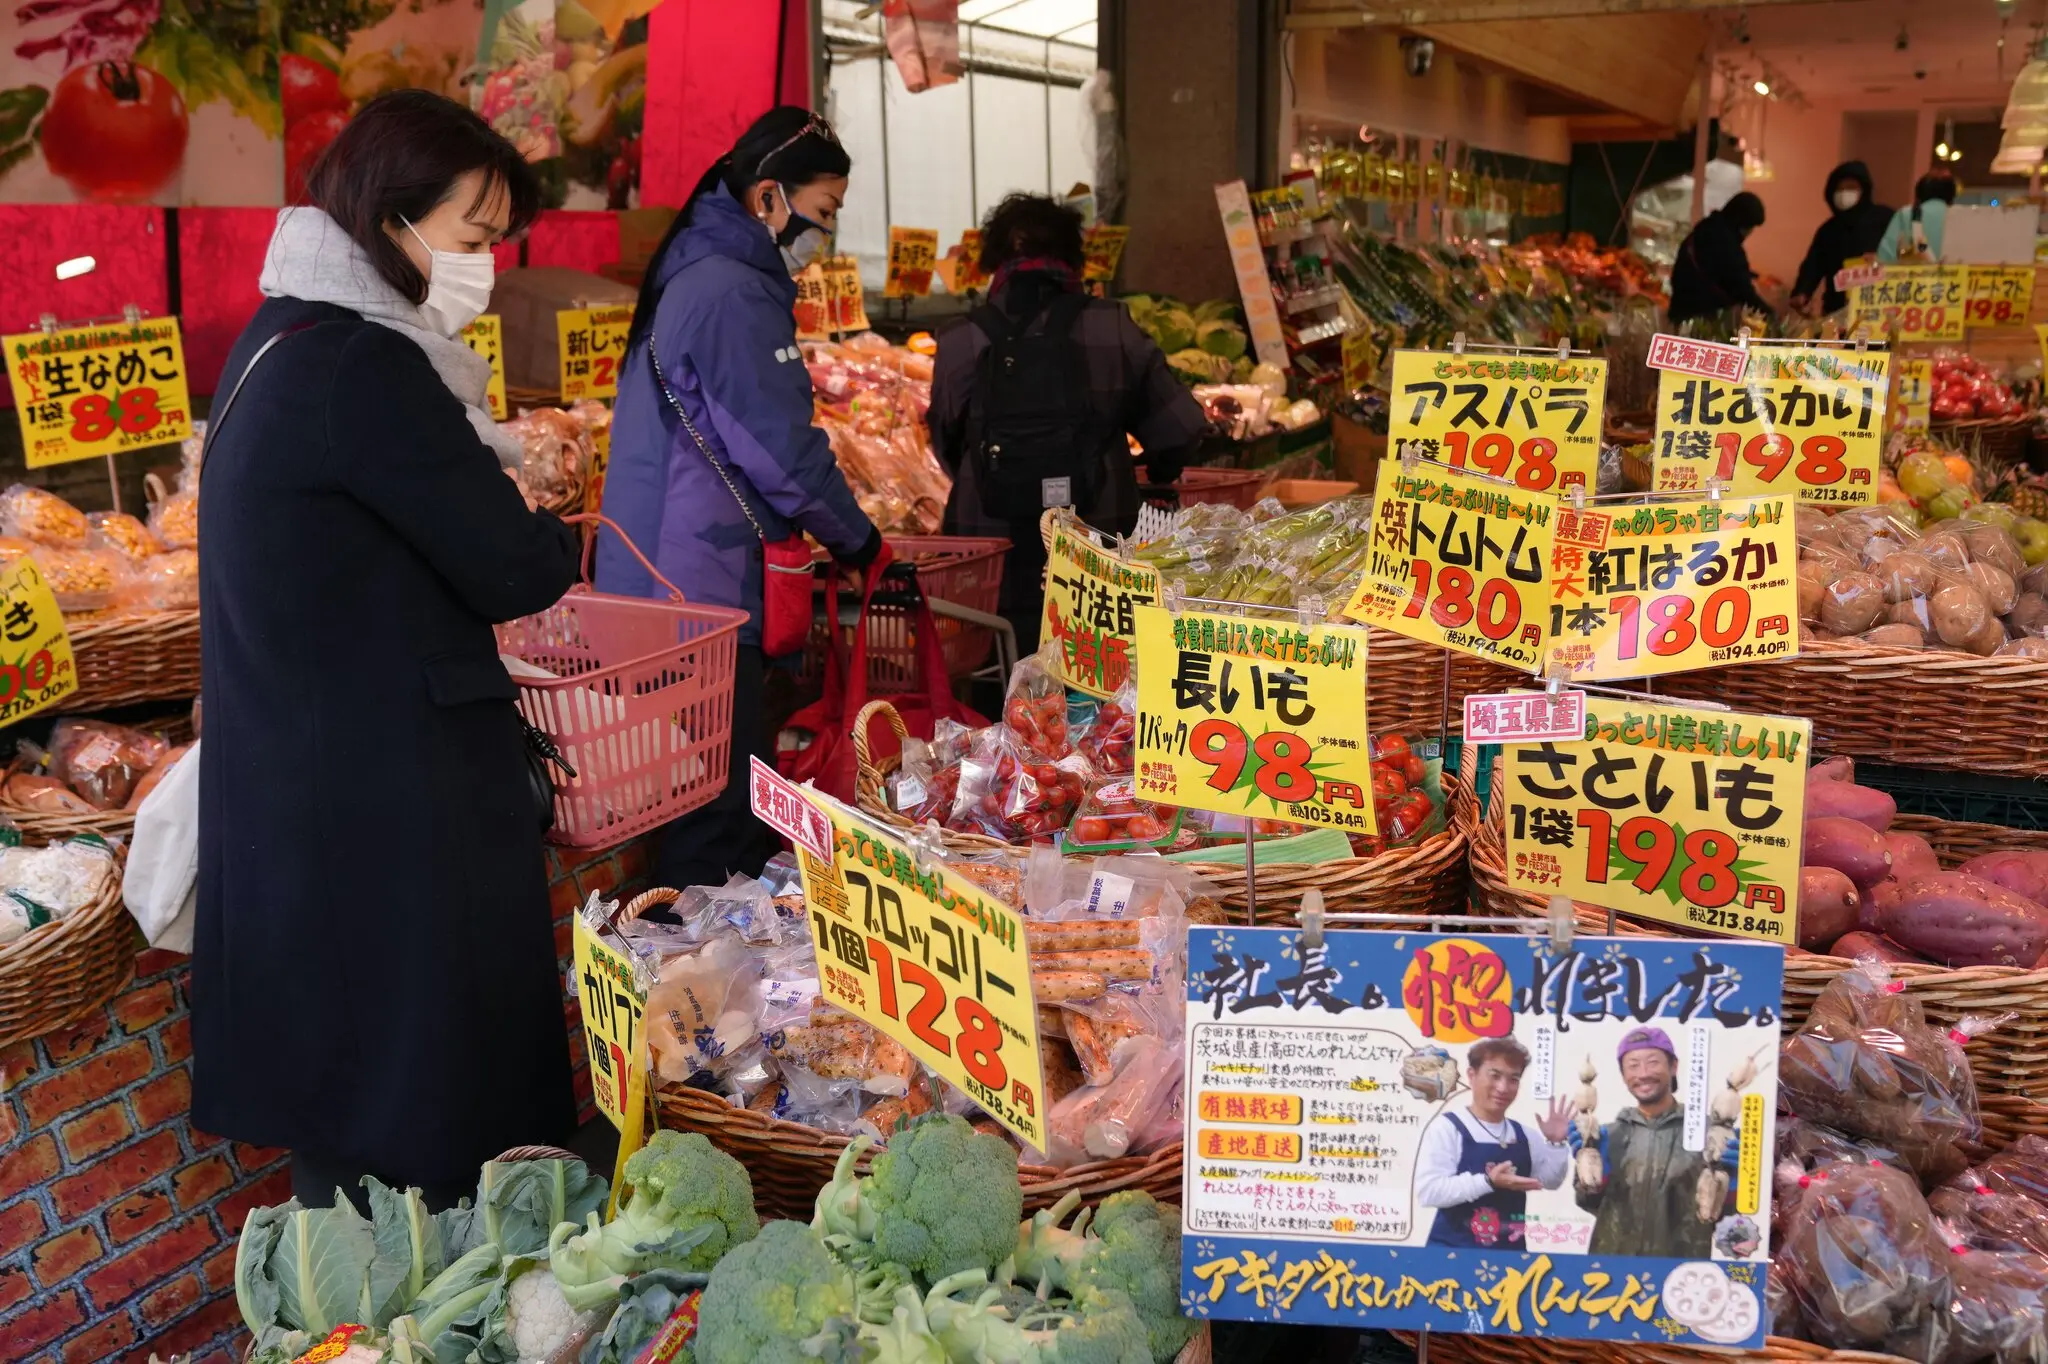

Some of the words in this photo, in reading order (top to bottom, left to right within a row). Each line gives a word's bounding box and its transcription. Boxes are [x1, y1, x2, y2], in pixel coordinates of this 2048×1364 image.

[44, 346, 179, 399] 生なめこ
[1433, 360, 1600, 384] とっても美味しい!!
[1656, 339, 1741, 377] 北海道産
[26, 402, 64, 424] 1袋
[70, 387, 186, 443] 88円
[1404, 381, 1590, 435] アスパラ
[1670, 380, 1874, 431] 北あかり
[1563, 435, 1597, 446] (本体価格)
[1838, 430, 1876, 440] (本体価格)
[1443, 431, 1587, 491] 198円
[1660, 430, 1713, 461] 1袋
[1714, 431, 1872, 486] 198円
[1658, 480, 1698, 490] アキダイ
[1797, 487, 1870, 503] (税込213.84円)
[1380, 498, 1409, 529] 中玉
[1556, 511, 1605, 544] 県産
[1373, 522, 1410, 553] トマト
[1408, 502, 1544, 584] トムトム
[1551, 547, 1585, 600] 特大
[1588, 537, 1779, 596] 紅はるか
[1370, 550, 1411, 584] 1パック
[1402, 558, 1542, 647] 180円
[1747, 578, 1790, 592] (本体価格)
[1353, 603, 1396, 621] アキダイ
[1550, 602, 1607, 637] 1本
[1609, 585, 1790, 661] 180円
[1443, 629, 1537, 665] (税込194.40円)
[1708, 640, 1790, 662] (税込194.40円)
[1560, 660, 1596, 673] キダイ
[1171, 650, 1317, 727] 長いも
[1472, 699, 1578, 734] 埼玉県産
[1139, 712, 1188, 757] 1パック
[1189, 718, 1365, 810] 98円
[1317, 736, 1360, 751] (本体価格)
[1139, 778, 1178, 796] アキダイ
[1516, 743, 1784, 831] さといも
[755, 774, 827, 852] 愛知県産
[1287, 804, 1367, 828] (税込105.84円)
[1530, 852, 1558, 864] 生鮮市場
[1737, 832, 1791, 849] (本体価格)
[1510, 804, 1575, 849] 1袋
[1577, 808, 1786, 914] 198円
[1528, 861, 1562, 875] FRESHLAND
[833, 822, 1016, 953] っても美味し〜い!!
[1514, 868, 1562, 888] アキダイ
[844, 869, 1016, 1002] ブロッコリー
[1685, 907, 1784, 937] (税込213.84円)
[826, 980, 867, 1012] アキダイ
[670, 1009, 689, 1046] 生産者
[813, 910, 871, 976] 1個
[867, 936, 1035, 1118] 128円
[963, 1074, 1037, 1141] (税込138.24円)
[1204, 1095, 1292, 1120] 有機栽培
[1206, 1132, 1295, 1159] 産地直送
